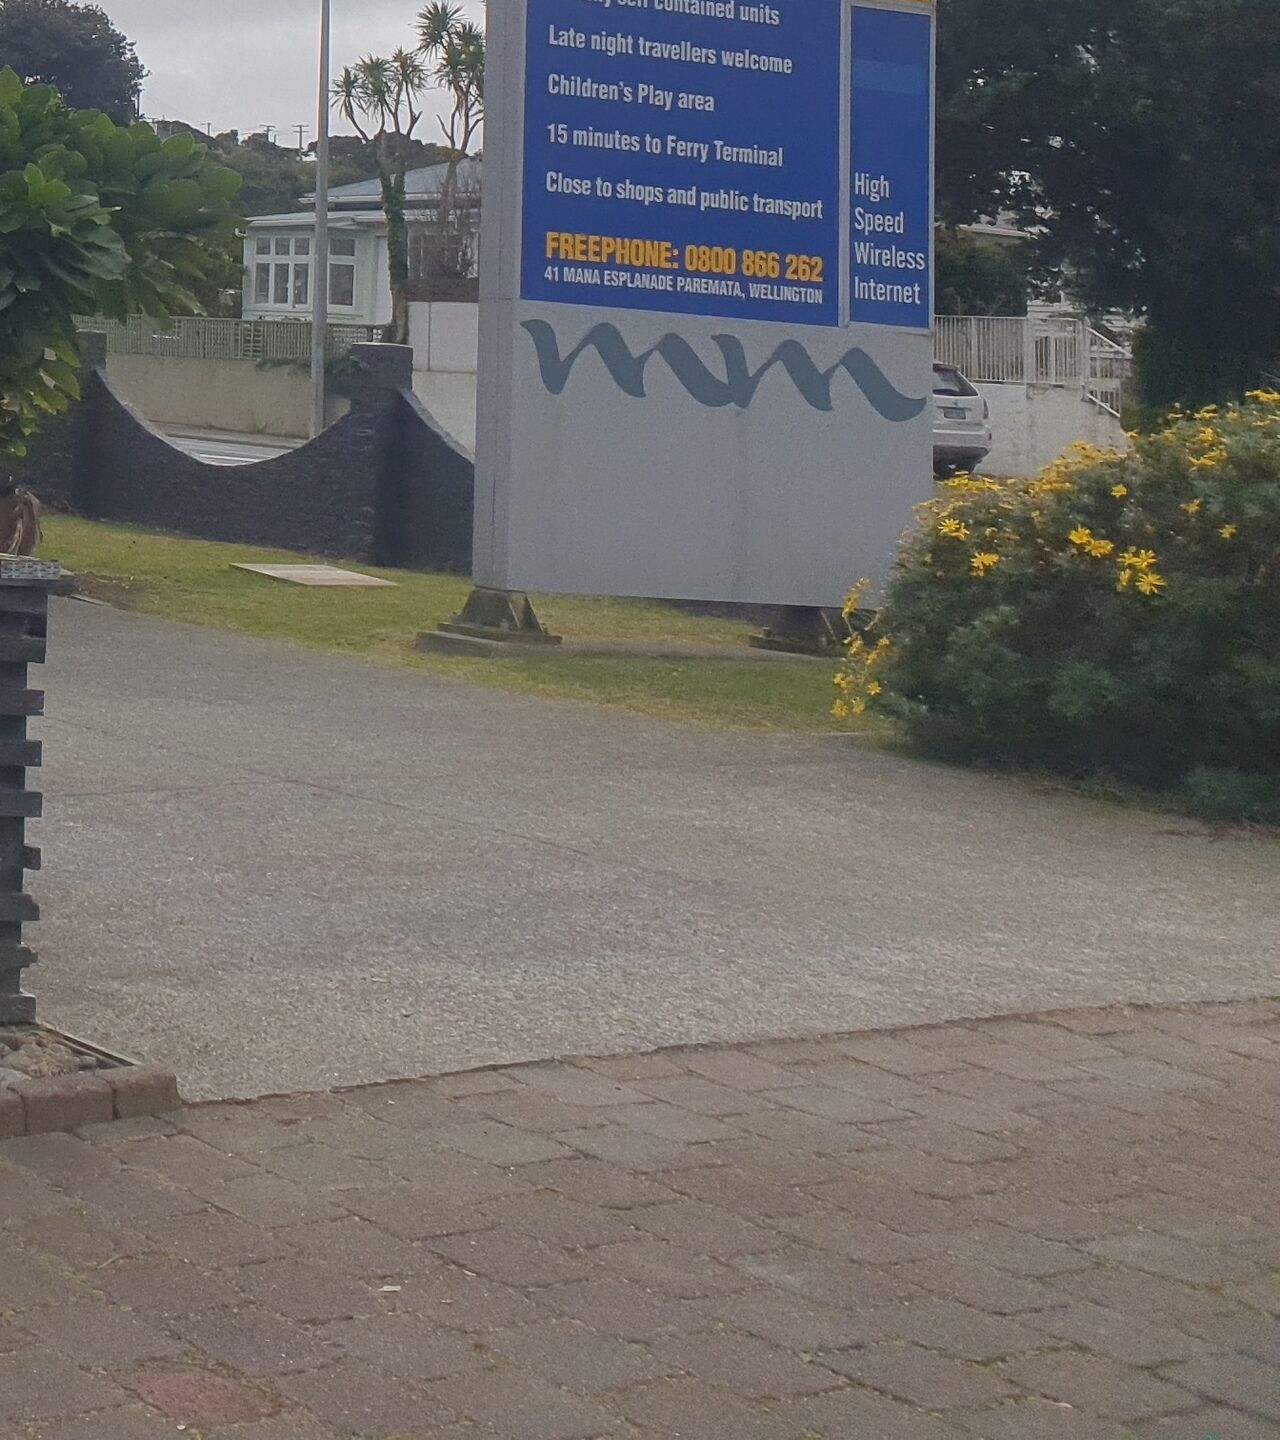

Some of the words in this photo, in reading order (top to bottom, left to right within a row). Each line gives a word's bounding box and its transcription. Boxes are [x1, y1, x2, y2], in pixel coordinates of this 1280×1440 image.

[739, 4, 780, 26] units
[548, 24, 585, 49] Late
[591, 30, 633, 56] night
[638, 36, 717, 65] travellers
[721, 48, 793, 74] welcome
[548, 73, 633, 102] Children's
[637, 83, 673, 111] Play
[677, 91, 715, 112] area
[546, 122, 568, 144] 15
[572, 126, 640, 152] minutes
[645, 133, 662, 154] to
[666, 134, 709, 163] Ferry
[713, 139, 784, 168] Terminal
[545, 171, 591, 195] Close
[596, 176, 612, 198] to
[616, 178, 663, 206] shops
[667, 186, 696, 206] and
[700, 188, 749, 212] public
[752, 193, 823, 221] transport
[854, 171, 890, 202] High
[854, 206, 904, 236] Speed
[545, 231, 680, 270] FREEPHONE:
[684, 244, 737, 274] 0800
[741, 249, 780, 279] 866
[784, 254, 824, 282] 262
[854, 241, 926, 271] Wireless
[544, 265, 560, 282] 41
[563, 266, 601, 285] MANA
[604, 270, 674, 292] ESPLANADE
[676, 278, 746, 299] PAREMATA,
[749, 283, 823, 304] WELLINGTON
[854, 276, 921, 305] Internet
